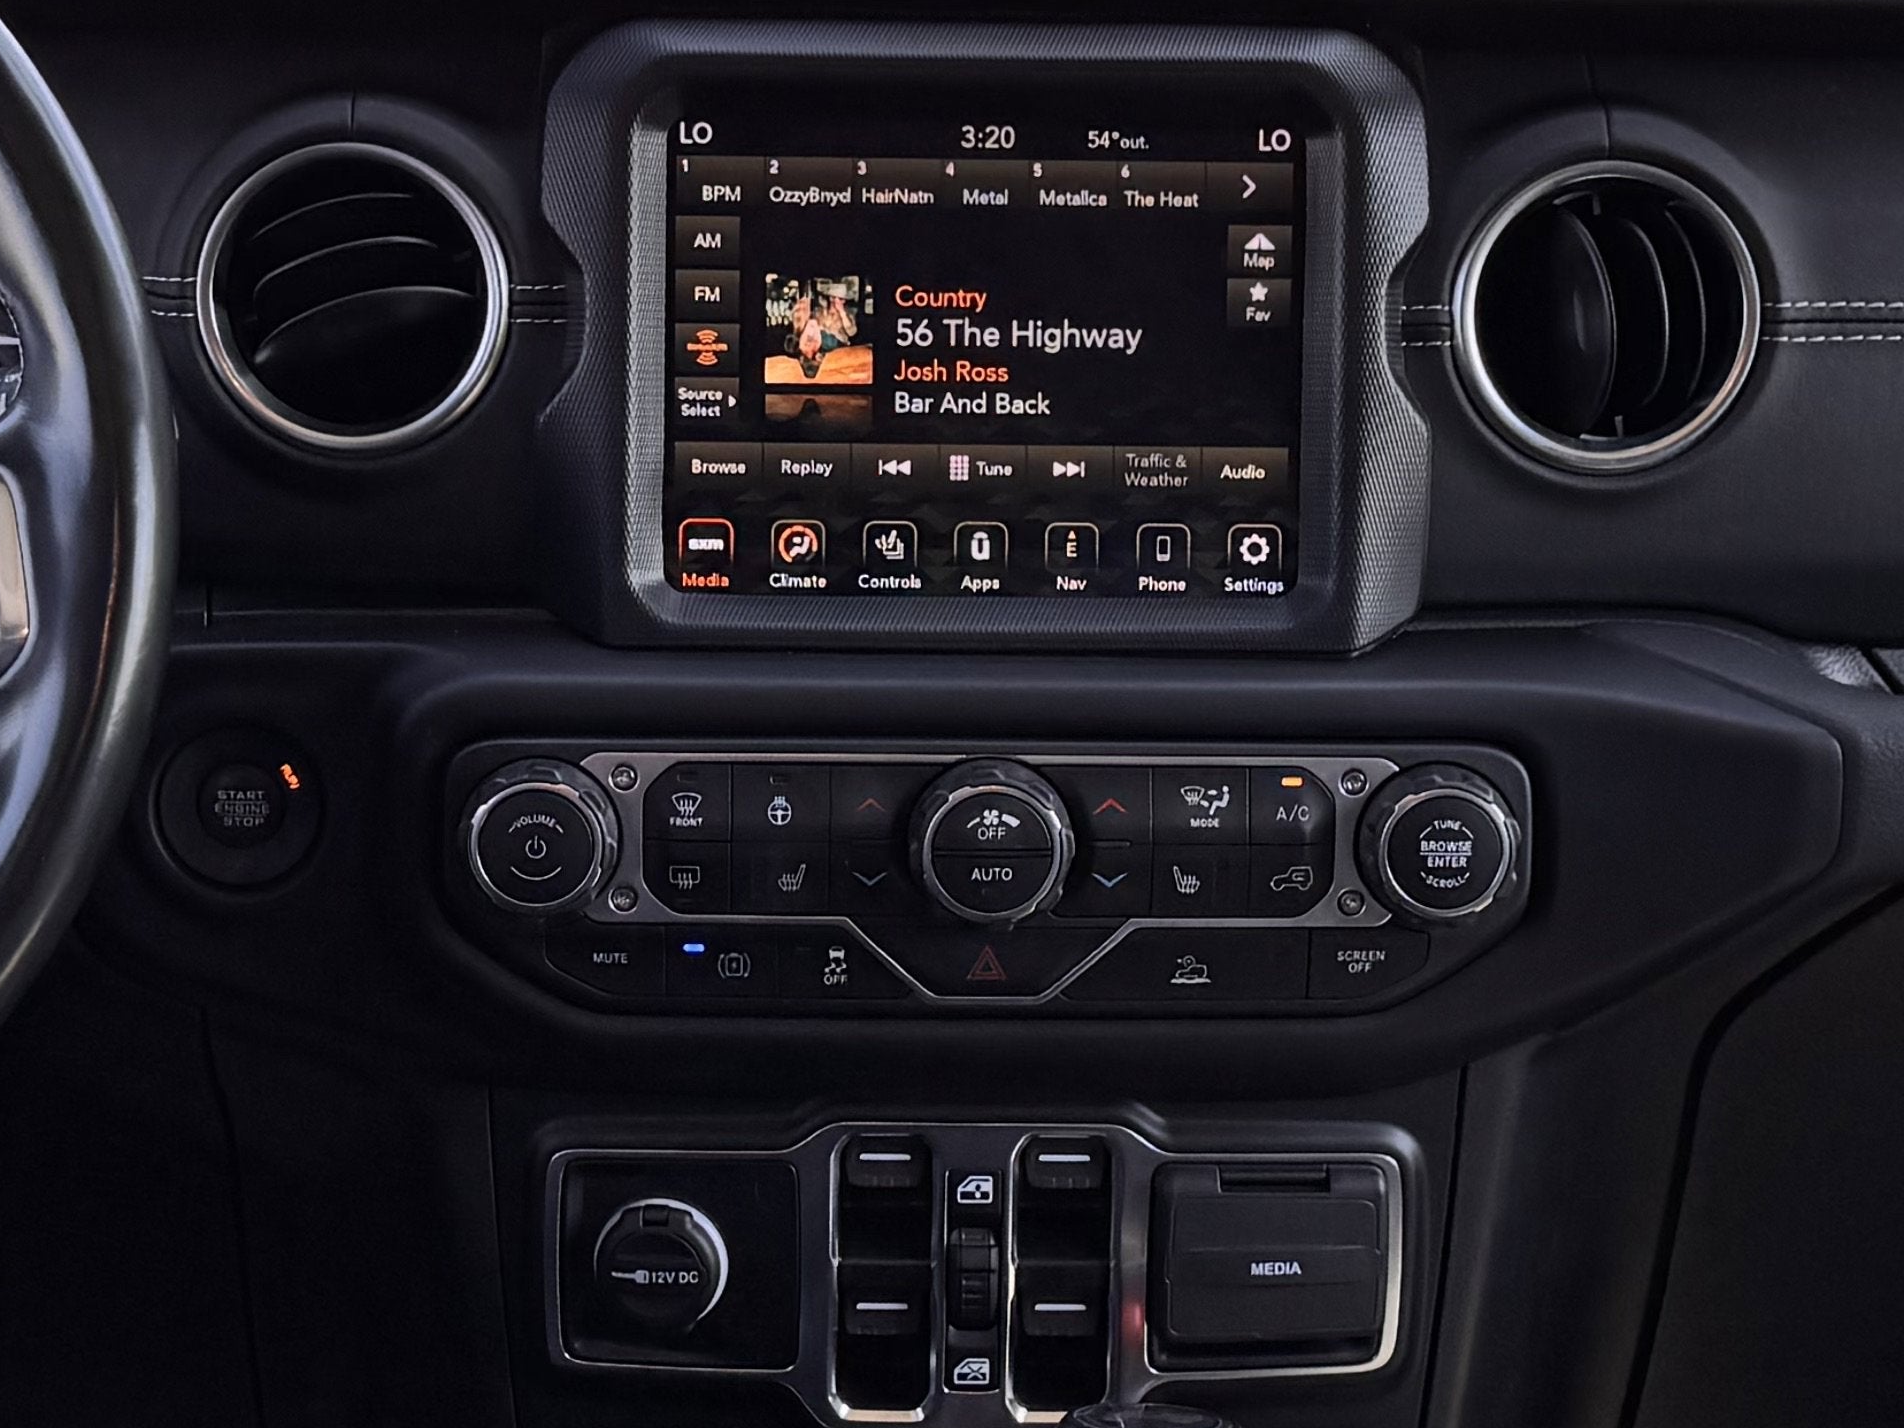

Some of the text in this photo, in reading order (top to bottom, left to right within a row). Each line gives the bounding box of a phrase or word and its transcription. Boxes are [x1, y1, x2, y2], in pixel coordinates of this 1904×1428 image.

[679, 122, 713, 145] LO
[961, 125, 1016, 149] 3:20
[1258, 128, 1292, 152] LO
[682, 159, 689, 172] 1
[769, 159, 779, 174] 2
[857, 160, 867, 175] 3
[945, 161, 955, 176] 4
[1120, 164, 1130, 178] 6
[702, 185, 741, 202] BPM
[769, 186, 851, 207] OzzyBnyd
[962, 188, 1009, 206] Metal
[1124, 189, 1199, 208] The Heat
[694, 233, 722, 248] AM
[1243, 253, 1275, 271] Map
[694, 286, 721, 302] FM
[895, 285, 987, 313] Country
[1246, 307, 1271, 322] Fav
[896, 317, 1143, 355] 56 The Highway
[894, 358, 1009, 382] Josh Ross
[677, 387, 723, 401] Source
[681, 403, 721, 417] Select
[895, 391, 1051, 415] Bar And Back
[691, 459, 746, 474] Browse
[781, 459, 833, 477] Replay
[1125, 453, 1171, 468] Traffic
[976, 461, 1013, 476] Tune
[1220, 464, 1266, 480] Audio
[1125, 473, 1189, 488] Weather
[682, 573, 729, 588] Media
[769, 573, 827, 589] Climate
[858, 574, 921, 590] Controls
[961, 575, 1000, 593] Apps
[1056, 576, 1087, 591] Nav
[1138, 577, 1186, 592] Phone
[1224, 577, 1284, 594] Settings
[217, 790, 265, 800] START
[1275, 804, 1310, 823] A/C
[224, 817, 264, 827] STOP
[669, 817, 703, 828] FRONT
[1189, 818, 1220, 829] MODE
[1433, 820, 1462, 831] TUNE
[977, 826, 1006, 840] OFF
[1420, 840, 1472, 852] BROWSE
[1427, 856, 1467, 868] ENTER
[971, 867, 1013, 882] AUTO
[1426, 875, 1466, 888] SCROLL
[593, 952, 629, 965] MUTE
[1337, 950, 1386, 962] SCREEN
[1348, 962, 1372, 974] OFF
[823, 973, 848, 985] OFF
[1250, 1261, 1302, 1276] MEDIA
[652, 1271, 699, 1284] 12V DC
